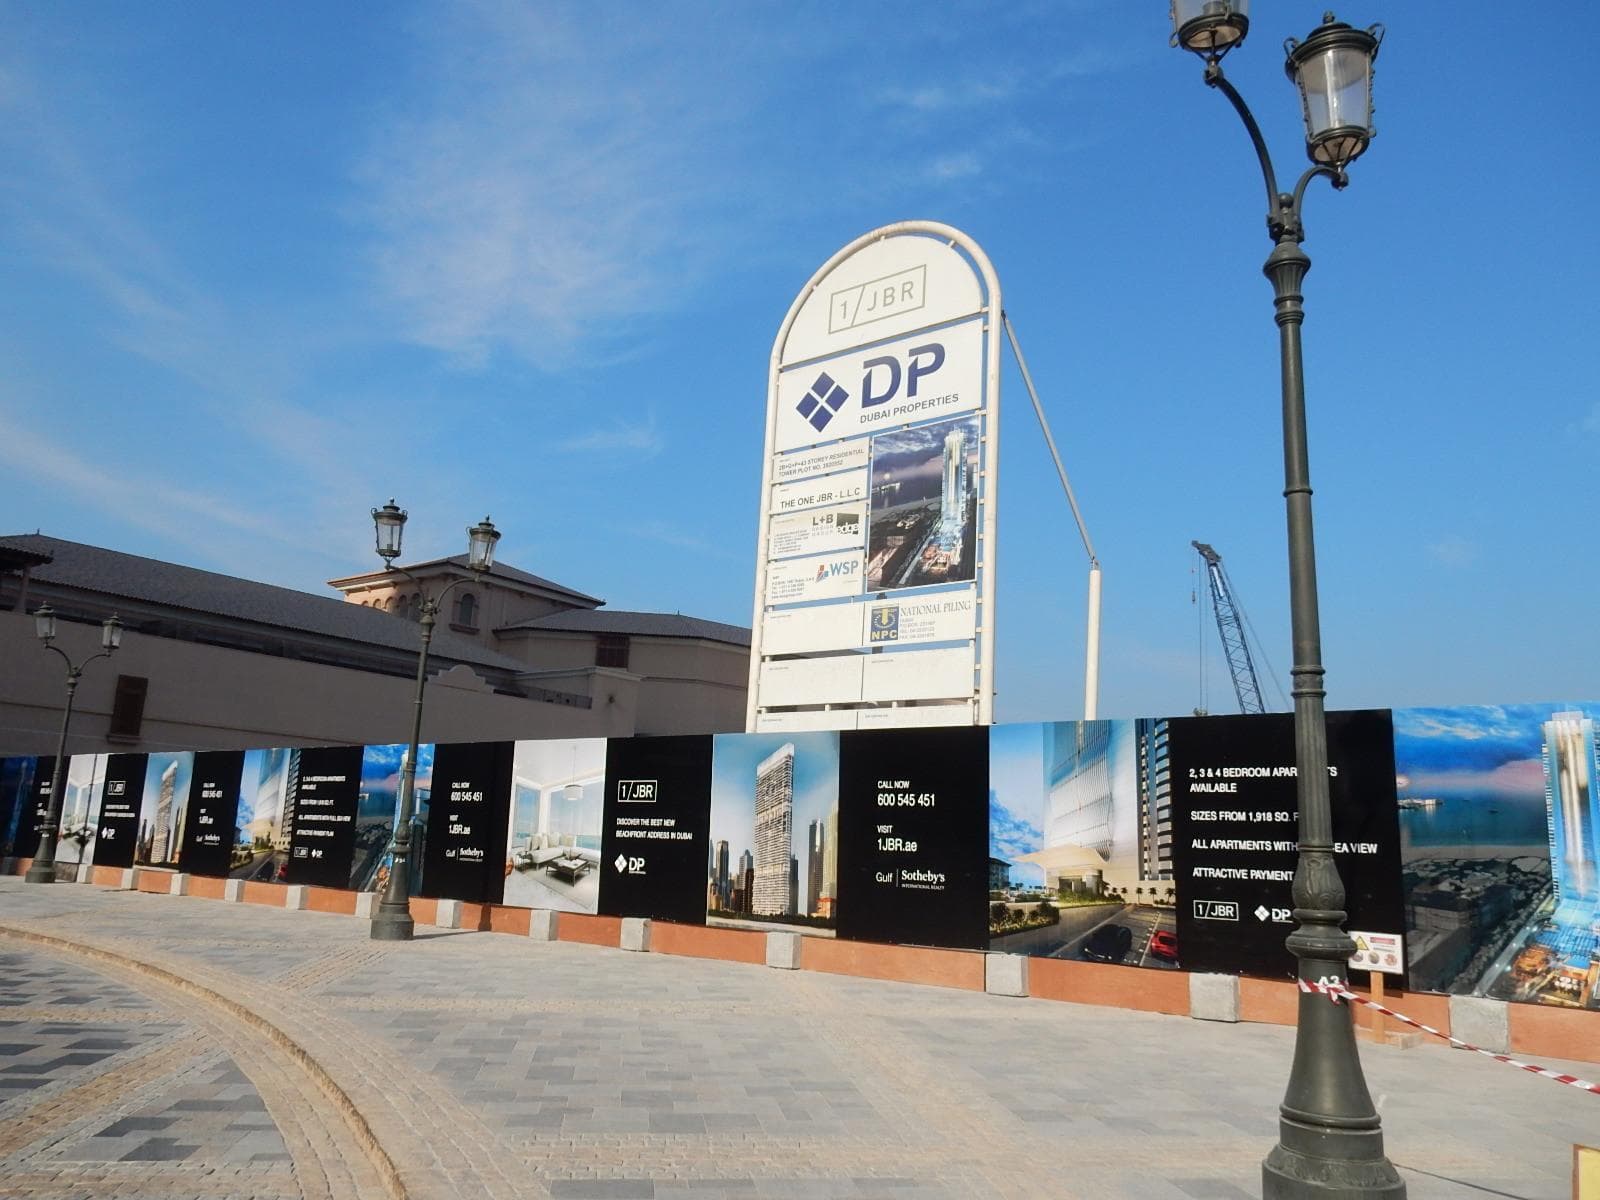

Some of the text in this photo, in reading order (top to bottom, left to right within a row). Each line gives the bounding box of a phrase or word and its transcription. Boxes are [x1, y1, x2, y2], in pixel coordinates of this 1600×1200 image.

[861, 342, 946, 409] DP
[860, 393, 959, 424] DUBAI PROPERTIES
[780, 498, 796, 510] THE
[797, 496, 815, 506] ONE
[817, 492, 833, 503] JBR
[830, 560, 858, 577] WSP
[900, 604, 941, 617] NATIONAL
[943, 600, 972, 612] PILING
[871, 629, 898, 641] NPC
[1189, 768, 1198, 779] 2,
[1199, 768, 1206, 778] 3
[1206, 767, 1214, 778] &
[1214, 767, 1221, 778] 4
[1223, 767, 1270, 778] BEDROOM
[877, 780, 910, 789] CALL NOW
[1190, 783, 1237, 793] AVAILABLE
[462, 791, 472, 801] 545
[473, 791, 483, 801] 451
[877, 793, 935, 807] 600 545 451
[641, 818, 650, 826] THE
[650, 818, 663, 826] BEST
[1191, 811, 1217, 822] SIZES
[1219, 811, 1246, 822] FROM
[1248, 811, 1272, 823] 1,918
[1274, 811, 1291, 822] SQ.
[647, 831, 670, 839] ADDRESS
[677, 832, 693, 840] DUBAI
[877, 825, 893, 833] VISIT
[877, 838, 917, 852] 1JBR.ae
[1191, 839, 1378, 855] ALL APARTMENTS WITH EA VIEW
[629, 857, 645, 871] DP
[875, 869, 945, 884] Gulf Sotheby's
[1192, 867, 1294, 881] ATTRACTIVE PAYMENT
[1271, 908, 1292, 921] DP
